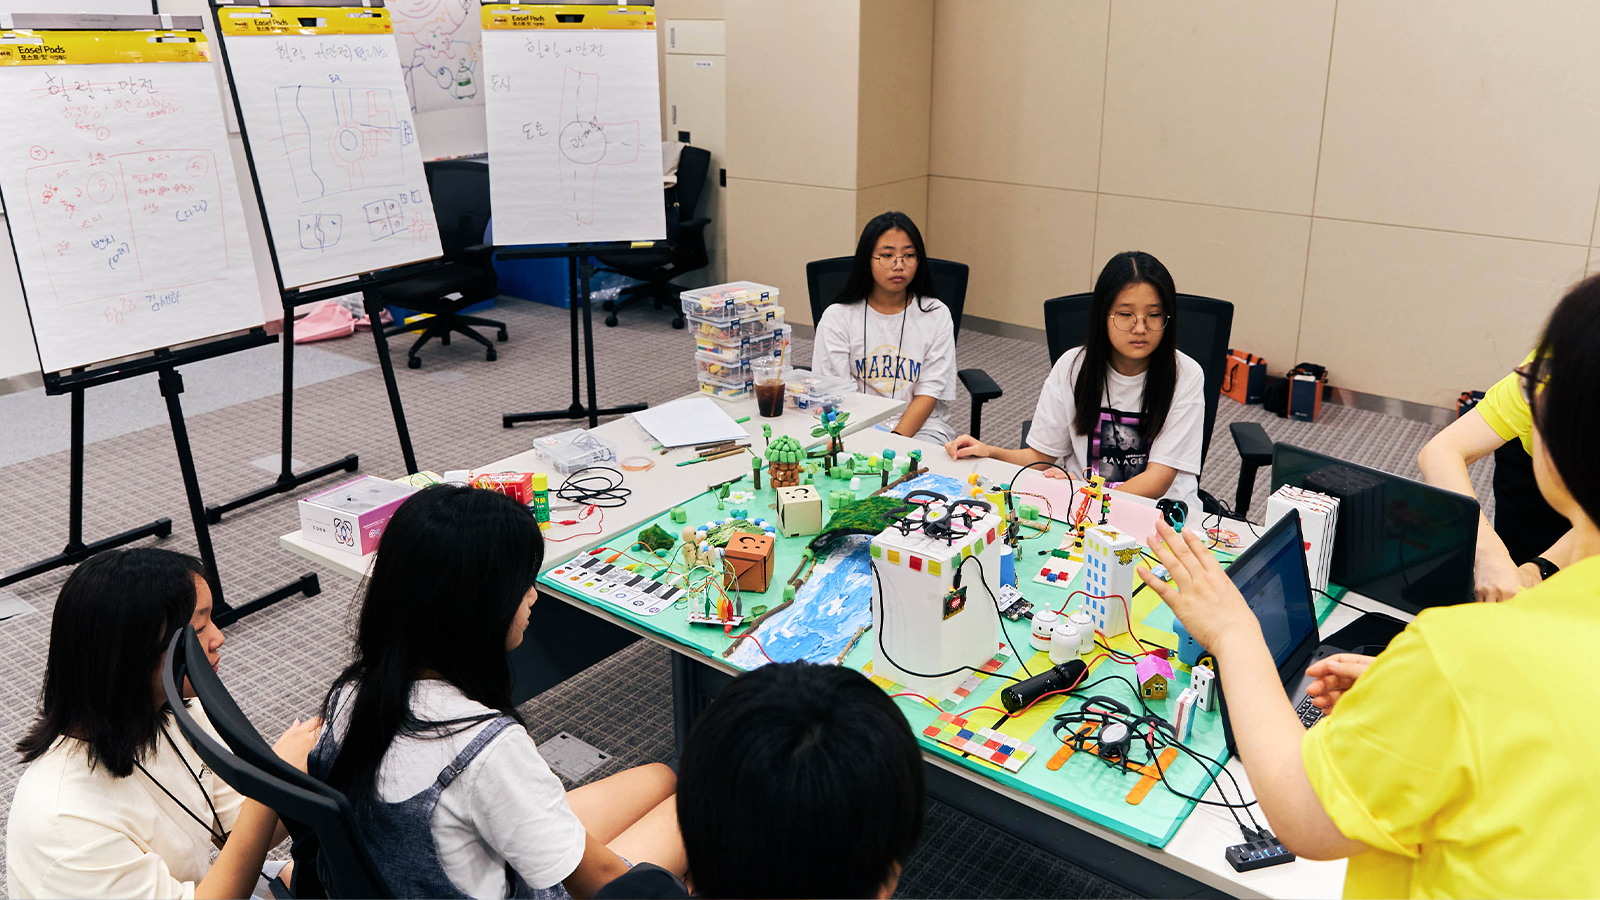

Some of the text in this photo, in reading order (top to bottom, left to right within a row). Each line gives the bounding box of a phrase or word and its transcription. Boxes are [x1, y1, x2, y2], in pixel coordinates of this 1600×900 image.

[18, 45, 66, 54] Easel Pads
[276, 41, 306, 62] 힐링
[525, 37, 560, 58] 힐링
[576, 42, 606, 57] 안전
[118, 76, 160, 95] 안전
[491, 74, 511, 92] 도시
[1102, 456, 1145, 466] SAVAGE
